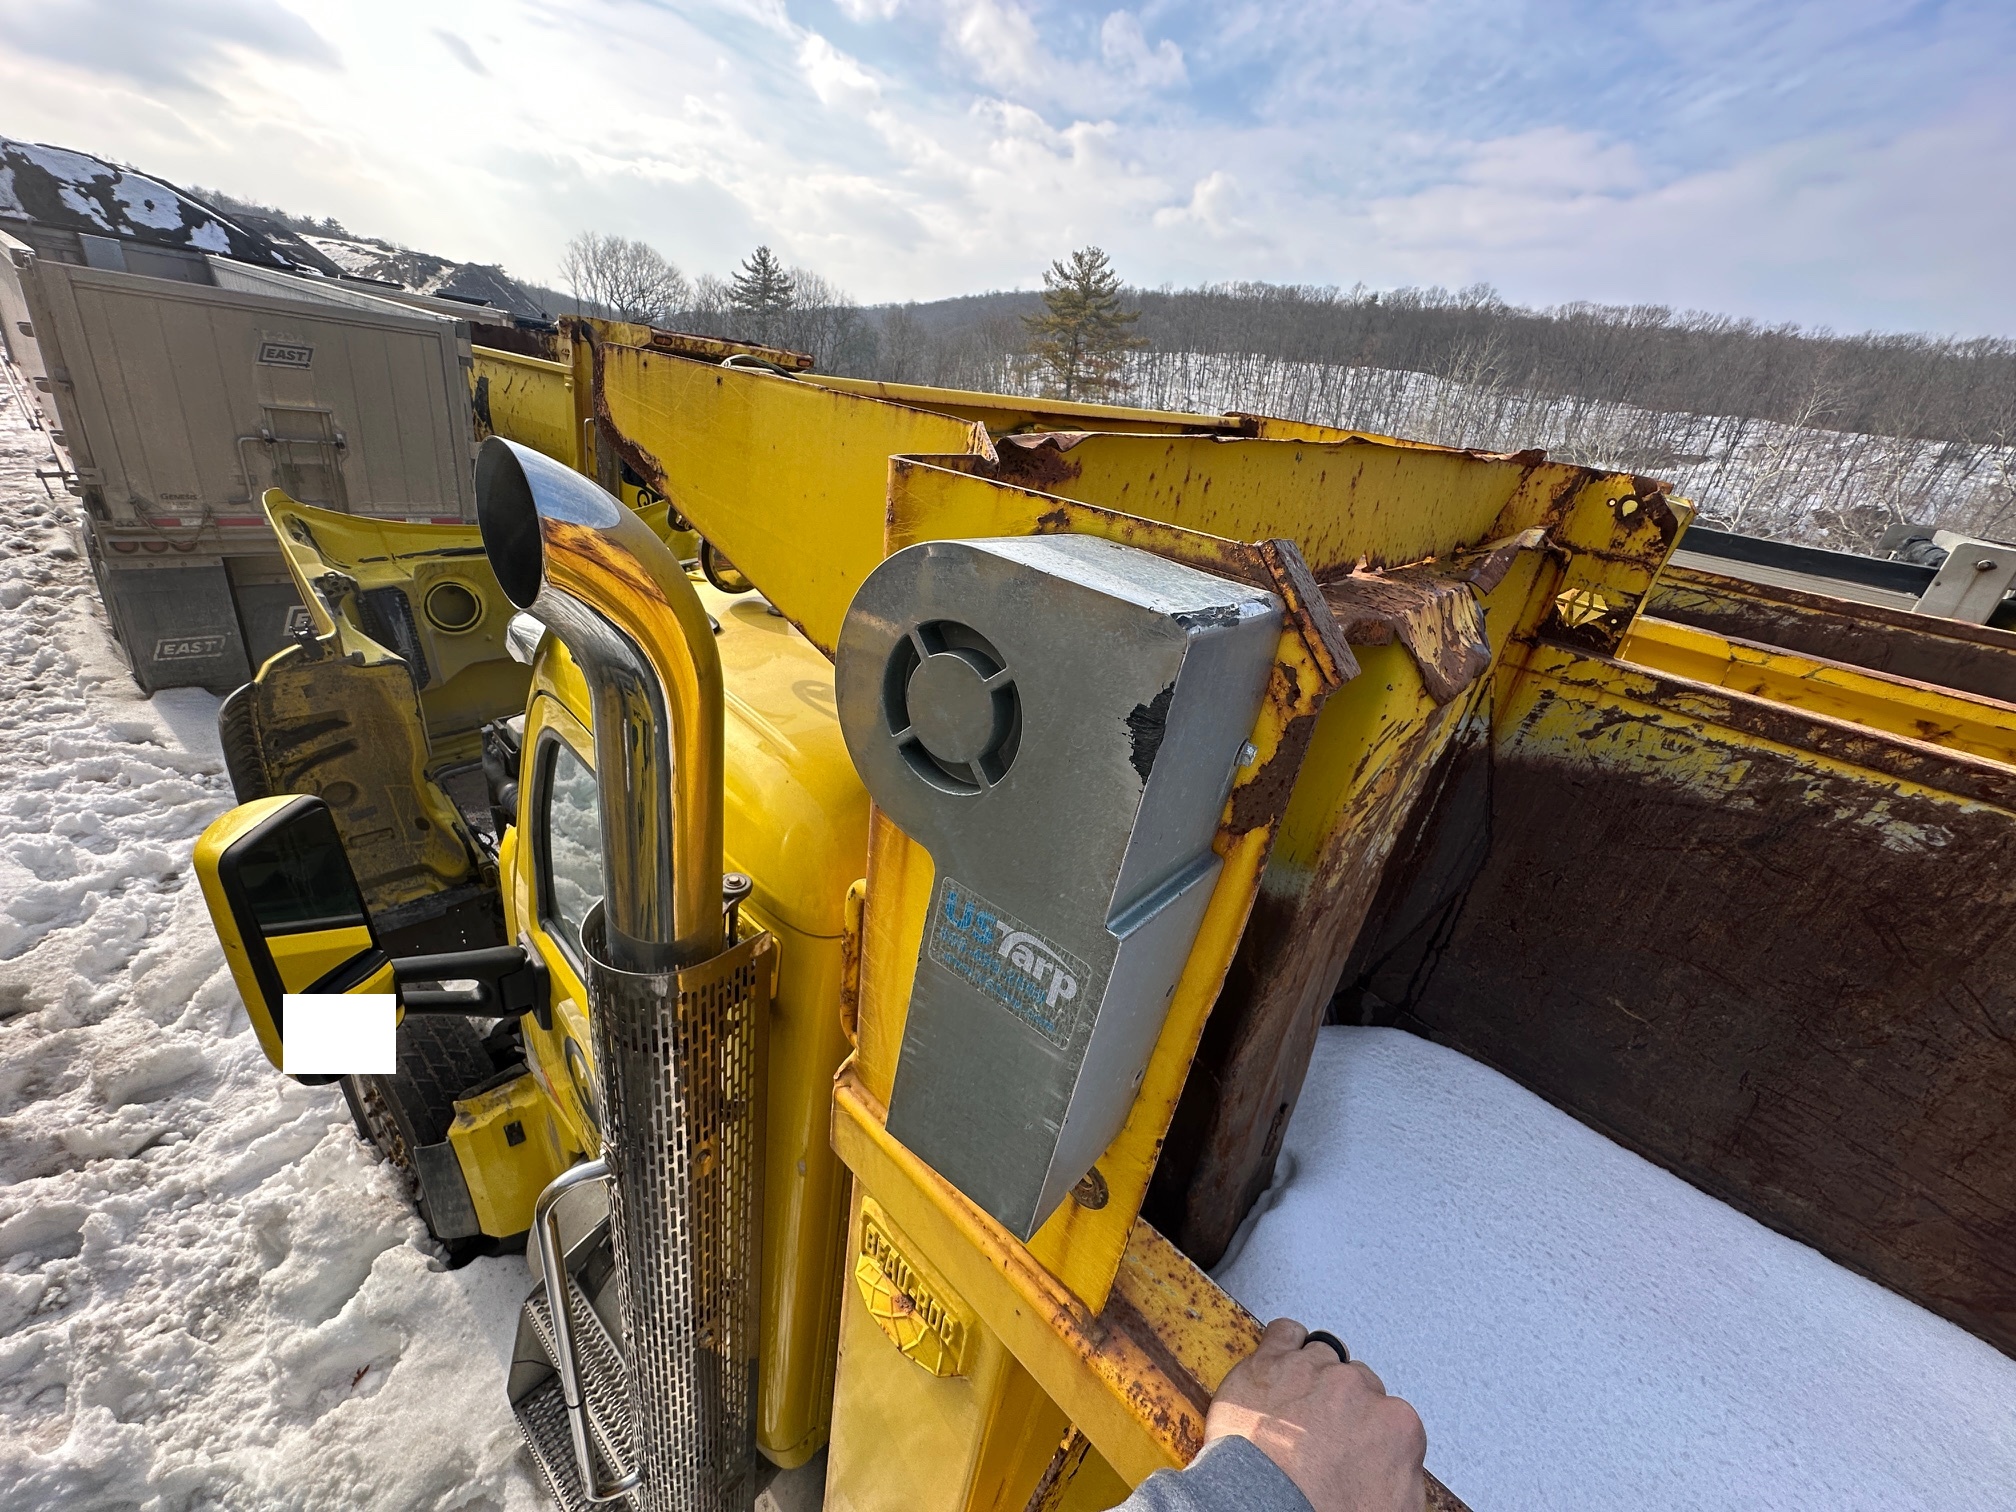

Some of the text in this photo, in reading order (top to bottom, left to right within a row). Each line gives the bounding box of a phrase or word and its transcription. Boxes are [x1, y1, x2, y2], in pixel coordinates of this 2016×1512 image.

[266, 348, 307, 361] EAST
[160, 492, 198, 500] GENESIS
[163, 640, 218, 655] EAST
